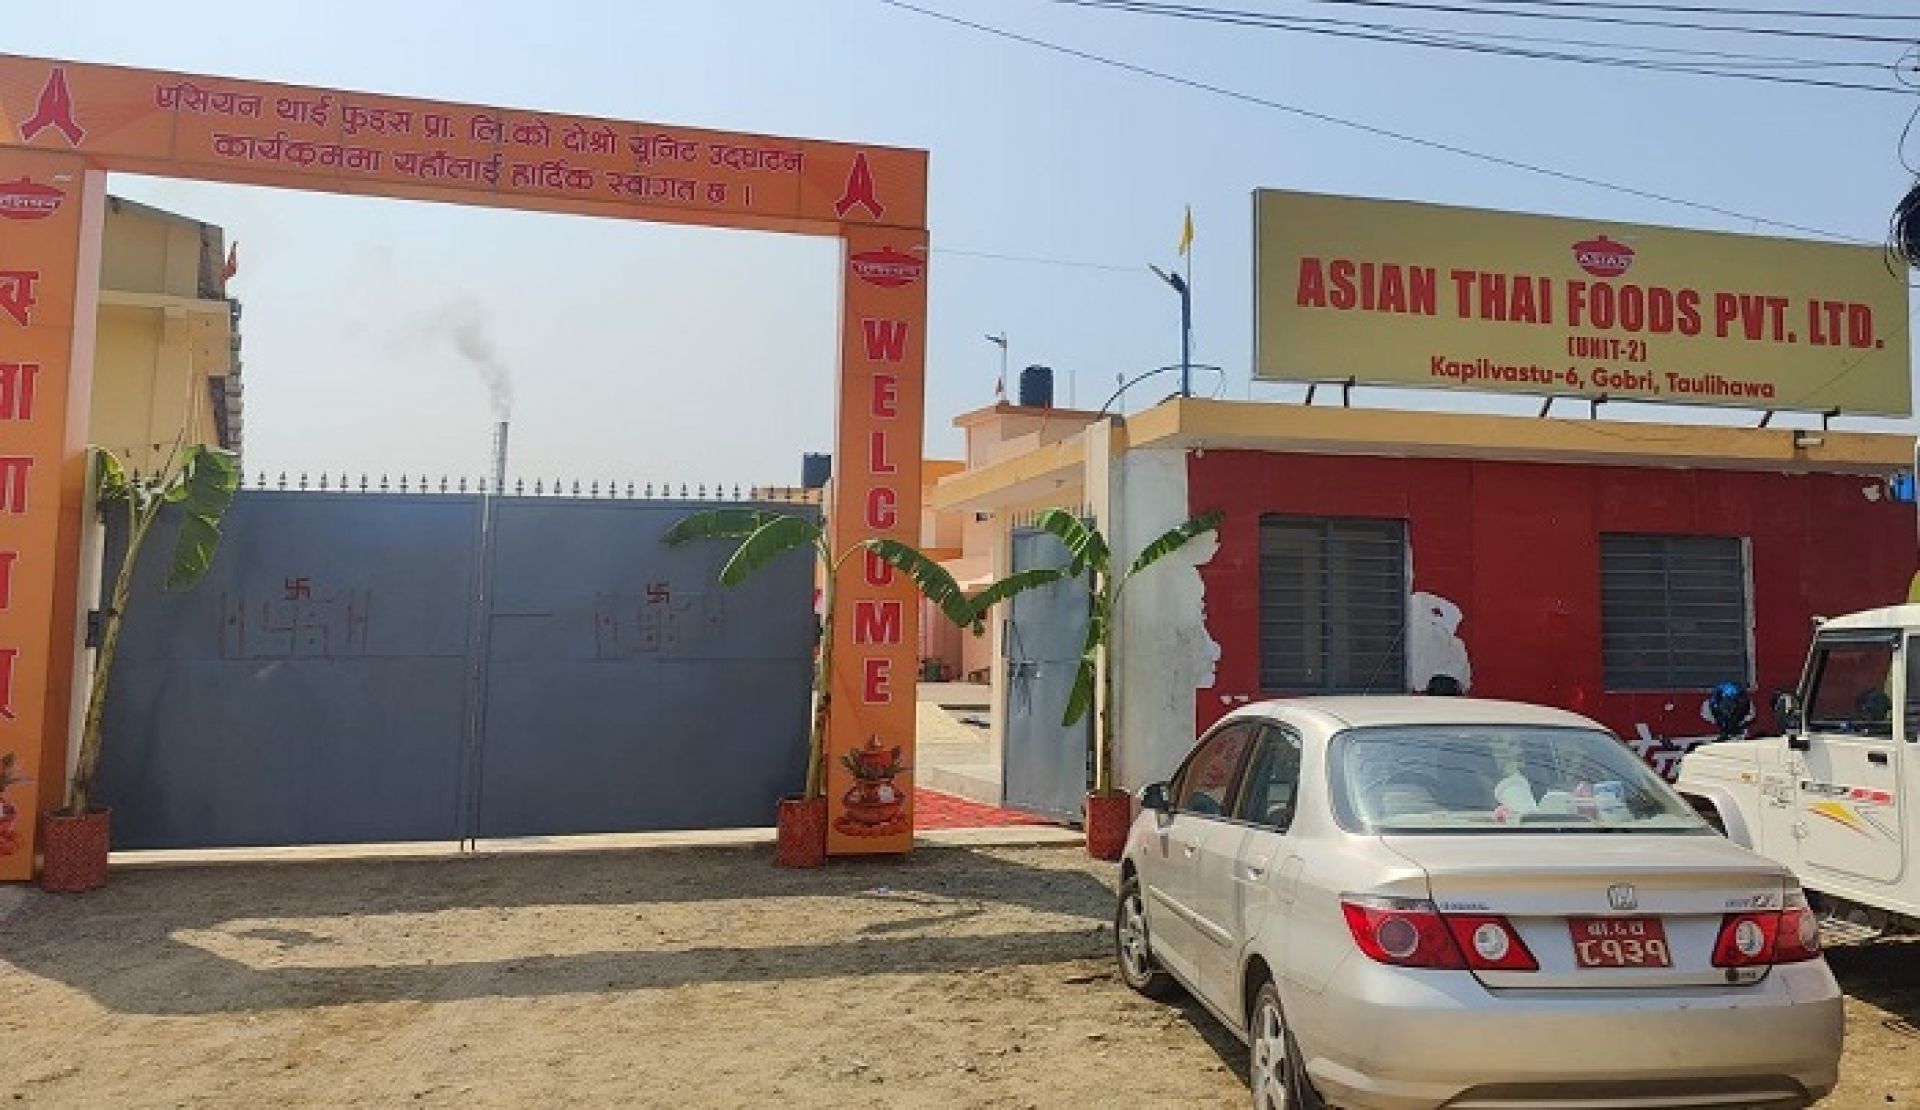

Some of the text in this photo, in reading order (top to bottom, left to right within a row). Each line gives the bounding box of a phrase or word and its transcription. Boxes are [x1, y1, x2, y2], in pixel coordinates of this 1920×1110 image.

[276, 95, 333, 128] थाई
[511, 158, 596, 191] हार्दिक
[605, 171, 698, 202] स्वागत
[1296, 256, 1885, 350] ASIAN THAI FOODS PVT. LTD.
[1430, 355, 1776, 398] Kapilvastu-6, Gobri, Taulihawa
[853, 317, 909, 705] WELCOME
